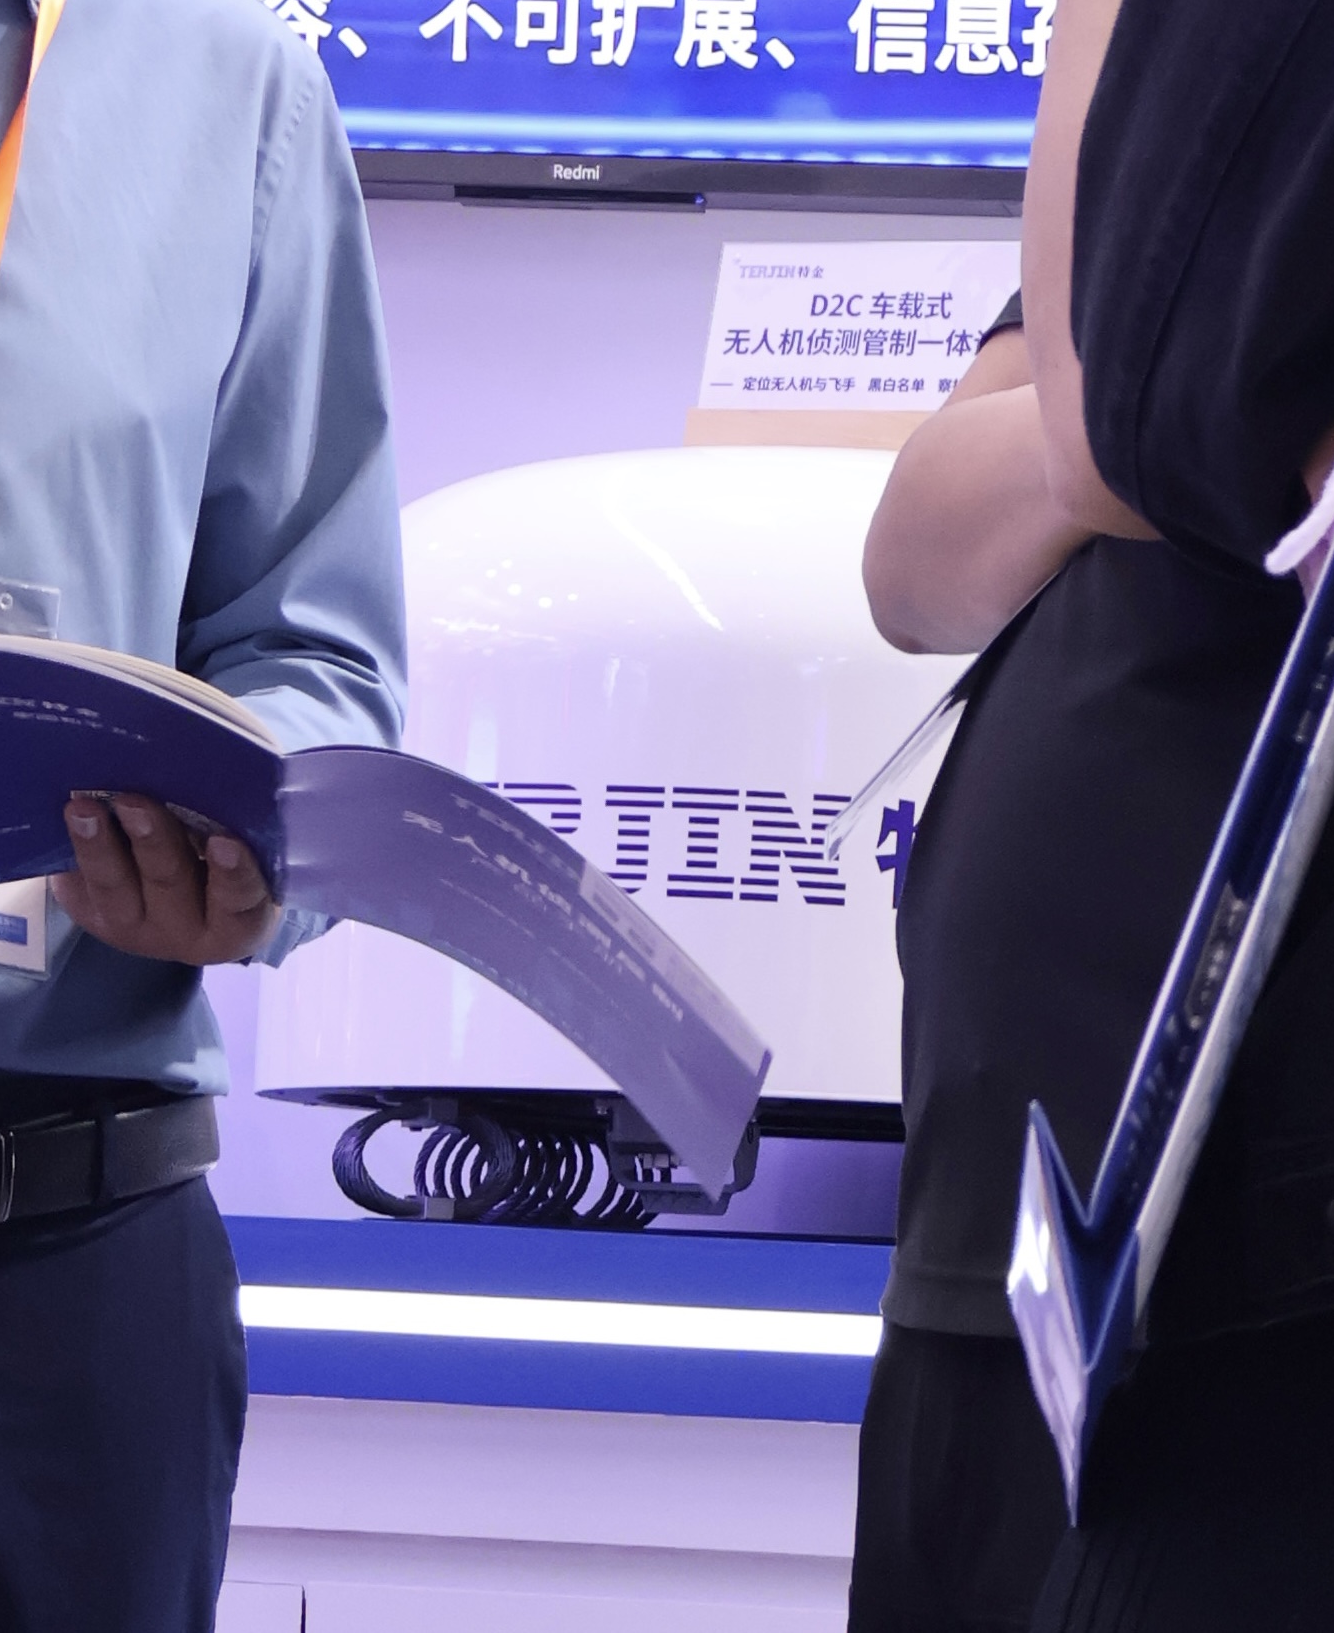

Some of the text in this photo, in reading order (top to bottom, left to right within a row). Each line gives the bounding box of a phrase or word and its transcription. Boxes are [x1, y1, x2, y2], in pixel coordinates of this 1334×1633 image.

[553, 164, 600, 181] Redmi
[810, 291, 954, 320] D2C 车载式
[742, 376, 856, 392] 定位无人机与飞手
[867, 377, 925, 393] 黑白名单
